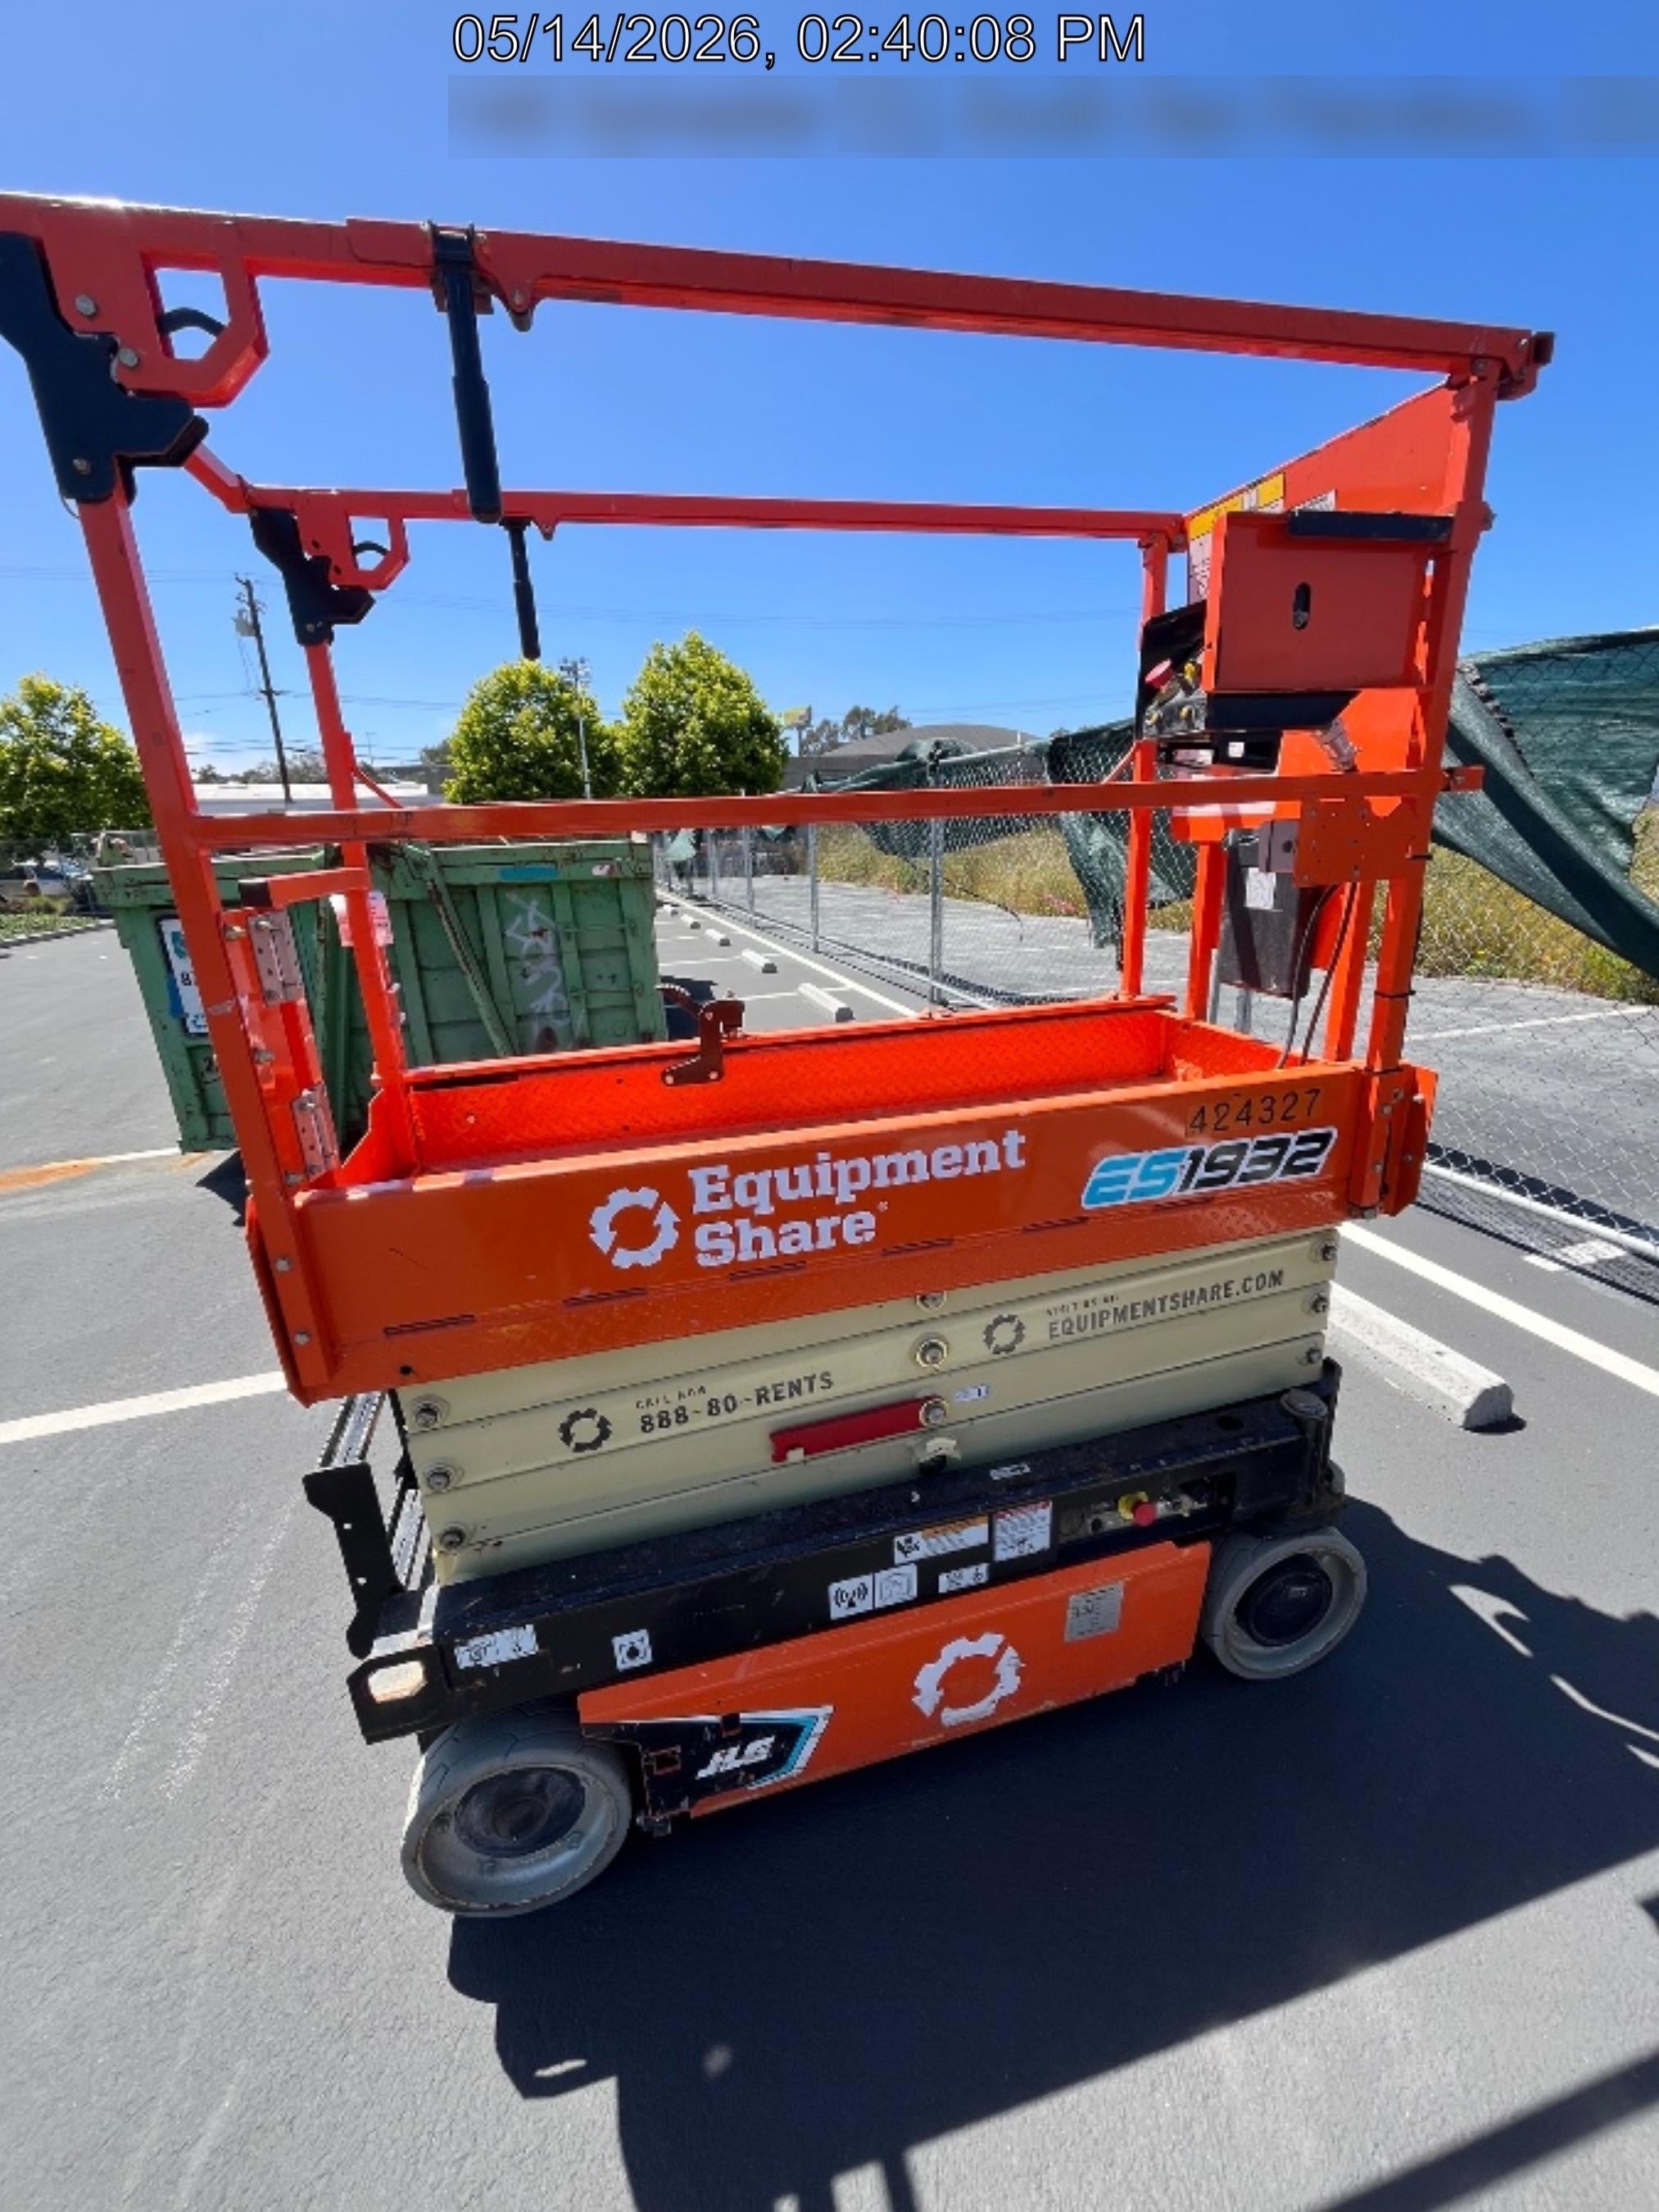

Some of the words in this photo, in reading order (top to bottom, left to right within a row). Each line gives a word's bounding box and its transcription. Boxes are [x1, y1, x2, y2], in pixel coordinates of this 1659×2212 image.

[1189, 1088, 1321, 1136] 424327
[687, 1130, 1026, 1216] Equipment
[1081, 1126, 1338, 1210] ES1932
[694, 1210, 877, 1269] Share
[1048, 1269, 1285, 1341] EQUIPMENTSHARE.COM
[640, 1371, 834, 1434] 888-80-RENTS
